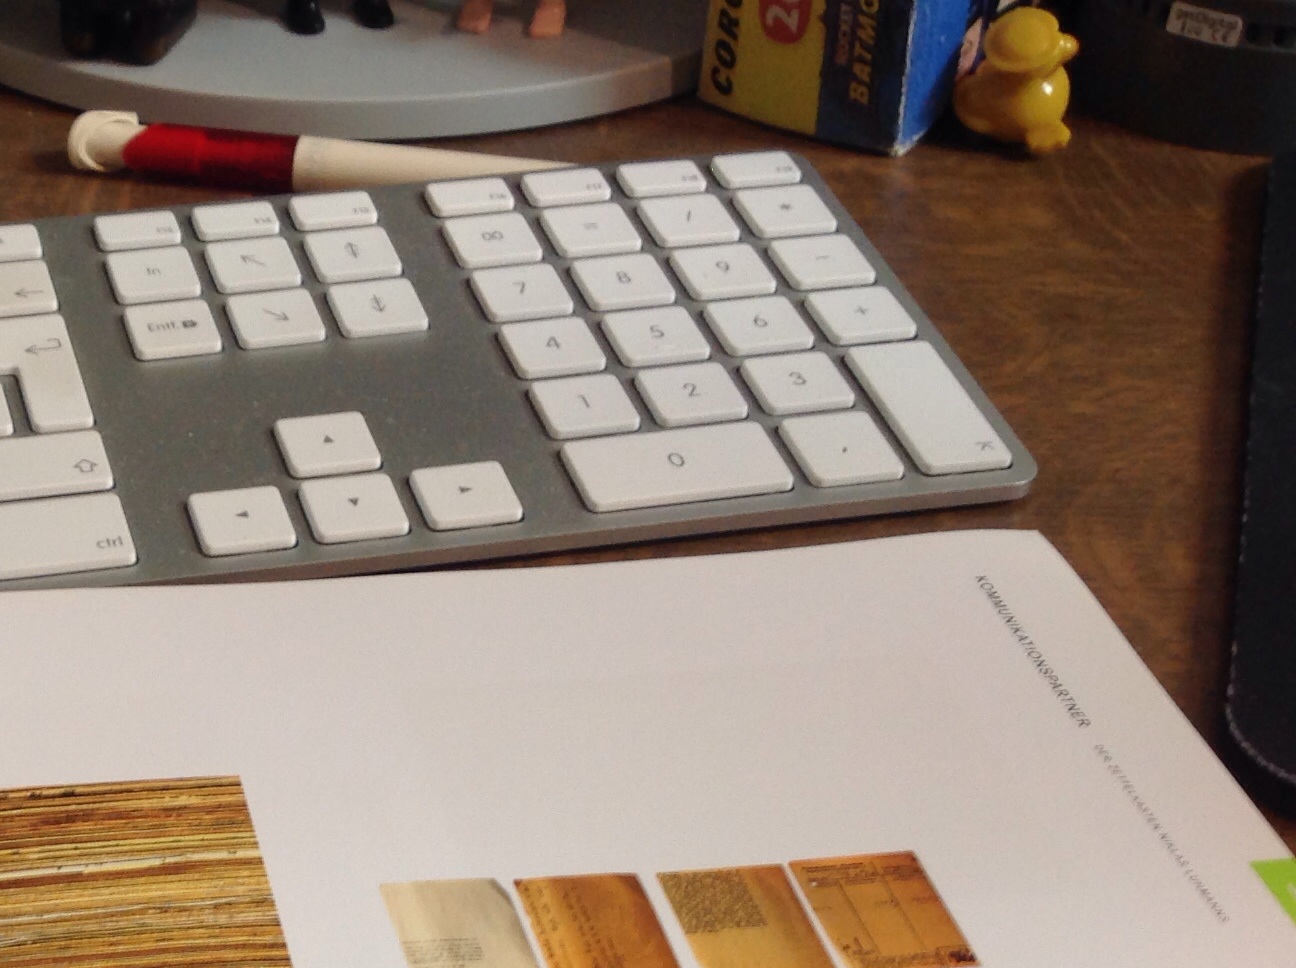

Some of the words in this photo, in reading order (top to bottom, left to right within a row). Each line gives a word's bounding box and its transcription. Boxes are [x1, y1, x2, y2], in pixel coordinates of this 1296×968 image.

[715, 260, 730, 273] 9
[616, 270, 631, 285] 8
[512, 281, 526, 296] 7
[753, 314, 768, 328] 6
[650, 324, 665, 339] 5
[546, 335, 561, 349] 4
[789, 371, 807, 386] 3
[682, 383, 701, 398] 2
[96, 535, 124, 549] ctrl
[975, 575, 1092, 728] KOMMUNIKATIONSPARTNER
